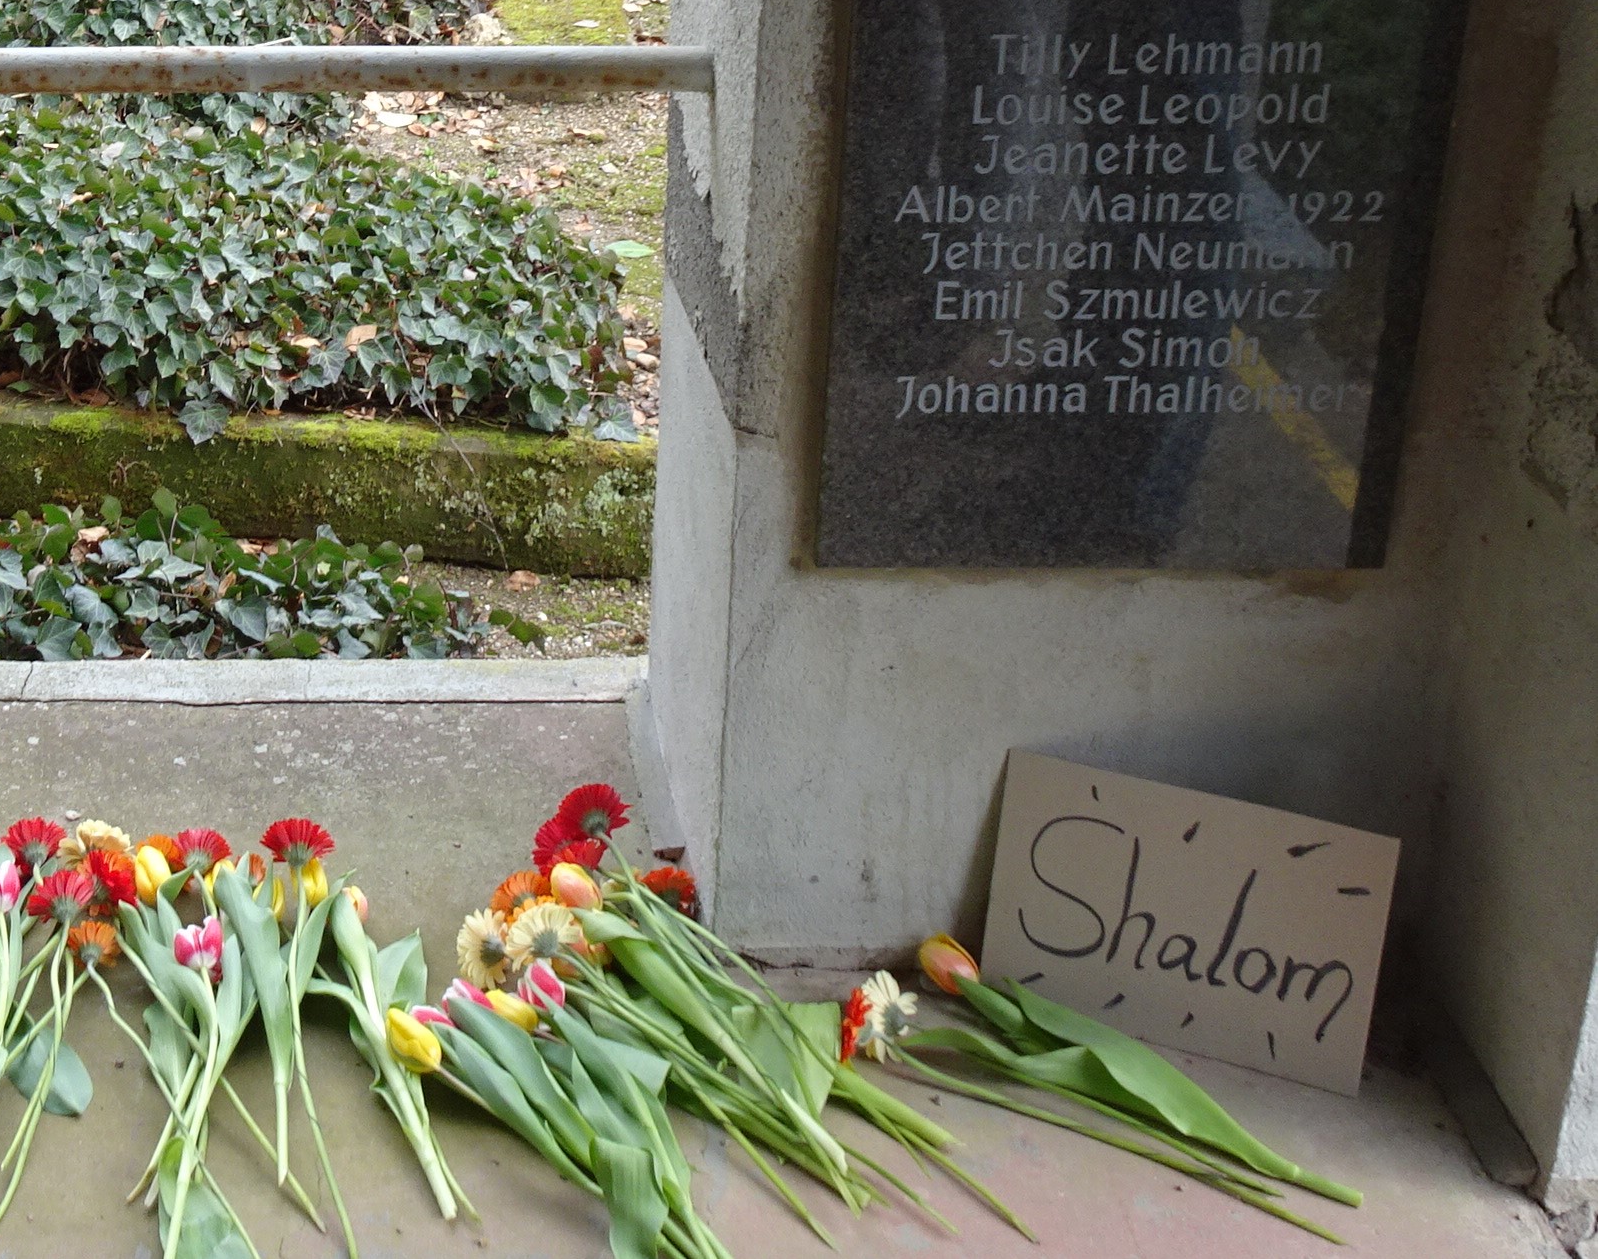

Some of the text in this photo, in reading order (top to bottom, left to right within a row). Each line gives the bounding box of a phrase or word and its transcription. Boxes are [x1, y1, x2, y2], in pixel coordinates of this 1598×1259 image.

[990, 32, 1323, 79] Tilly Lehmann
[972, 82, 1332, 132] Louise Leopold
[974, 133, 1323, 179] Jeanette Levy
[894, 184, 1385, 224] Albert Mainzer 1922
[920, 231, 1354, 275] Jettchen Neumann
[935, 279, 1322, 321] Emil Szmulewicz
[1119, 328, 1259, 369] Simon
[896, 375, 1350, 420] Johanna Thalheimer
[1018, 815, 1353, 1043] Shalom
